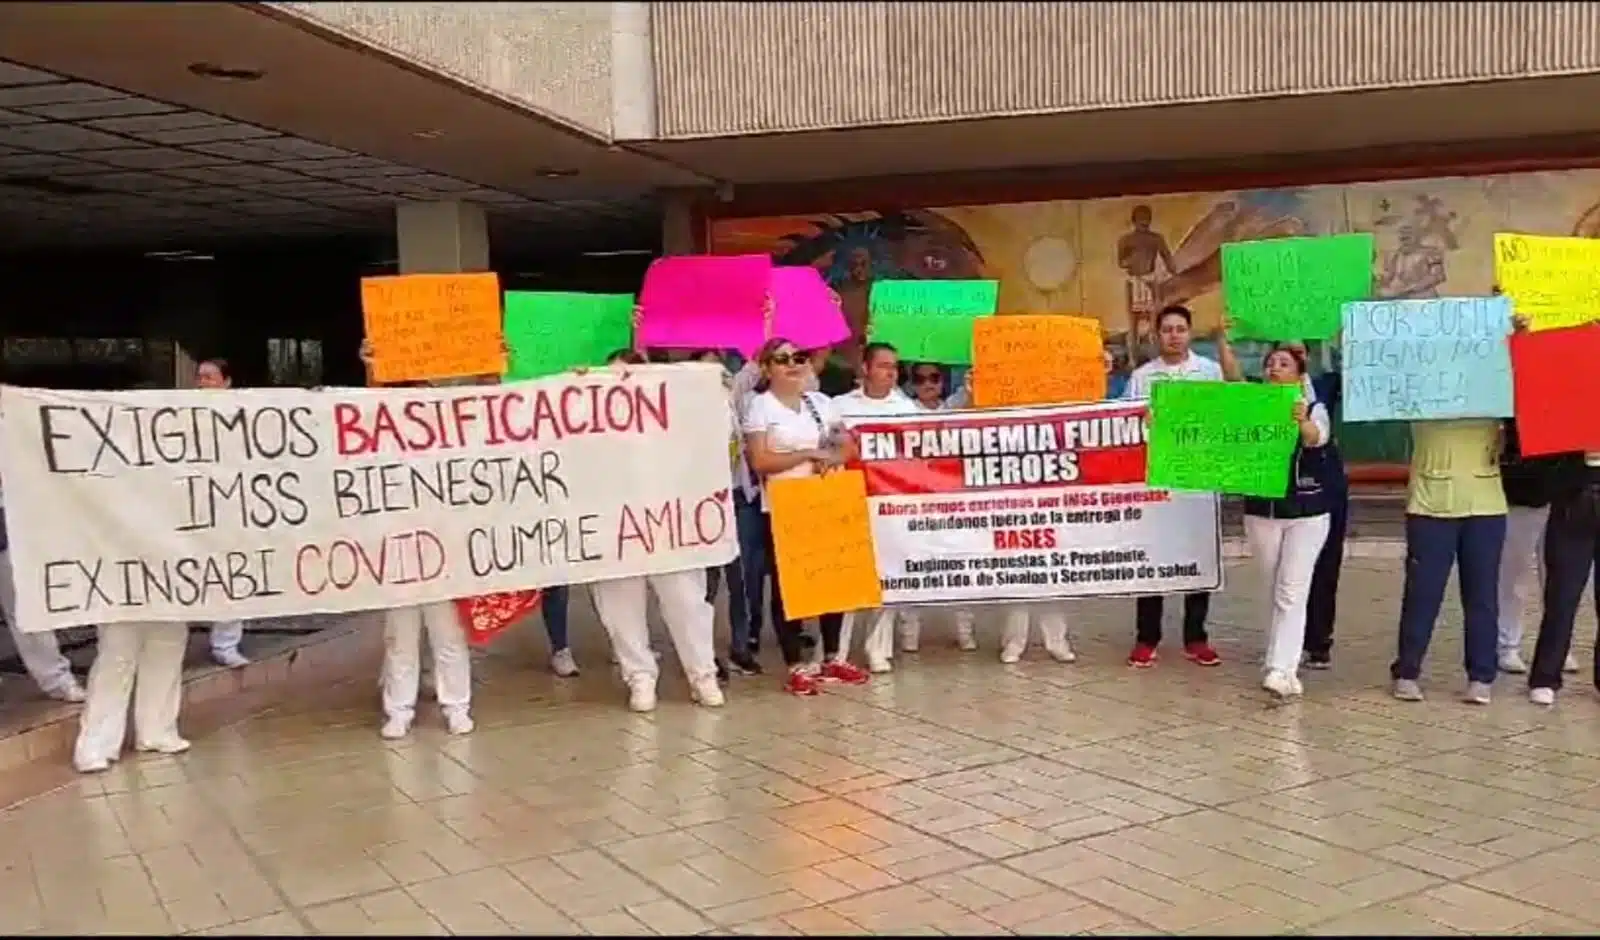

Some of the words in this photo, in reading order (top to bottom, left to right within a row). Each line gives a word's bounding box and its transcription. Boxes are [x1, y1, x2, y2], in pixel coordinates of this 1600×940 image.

[40, 405, 318, 473] EXIGIMOS
[335, 375, 669, 456] BASIFICACIÓN
[860, 432, 896, 461] EN
[903, 423, 1058, 459] PANDEMIA
[964, 451, 1080, 487] HEROES
[176, 473, 308, 531] IMSS
[334, 450, 569, 518] BIENESTAR
[878, 501, 918, 516] Ahora
[921, 499, 966, 515] somos
[1063, 491, 1098, 506] IMSS
[992, 512, 1027, 528] fuera
[1031, 511, 1047, 525] de
[1051, 510, 1063, 524] la
[1066, 508, 1121, 525] entrega
[1124, 506, 1142, 521] de
[467, 514, 602, 577] CUMPLE
[617, 497, 727, 561] AMLO
[993, 526, 1057, 550] BASES
[905, 556, 966, 574] Exigimos
[1051, 550, 1069, 567] Sr.
[923, 573, 944, 589] del
[977, 571, 994, 586] de
[996, 567, 1048, 585] Sinaloa
[1051, 569, 1059, 583] y
[1061, 563, 1135, 583] Secretario
[1137, 562, 1155, 578] de
